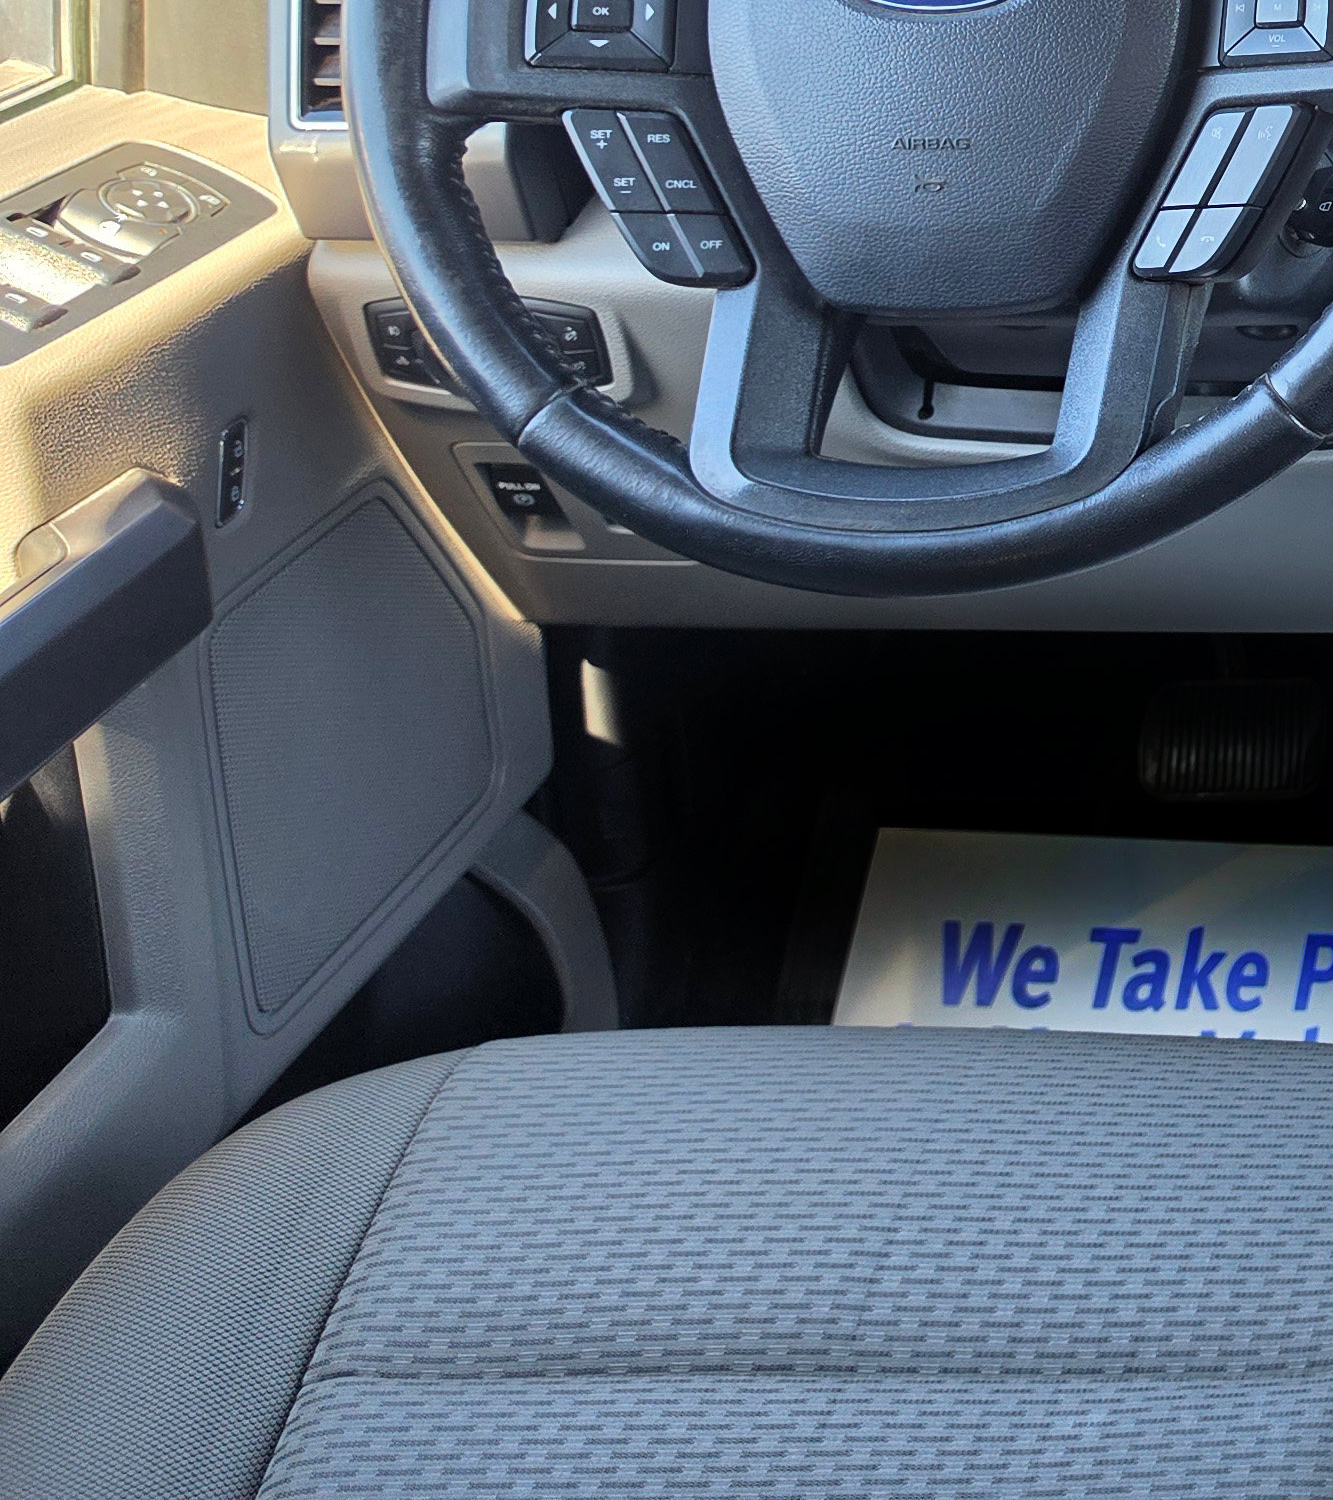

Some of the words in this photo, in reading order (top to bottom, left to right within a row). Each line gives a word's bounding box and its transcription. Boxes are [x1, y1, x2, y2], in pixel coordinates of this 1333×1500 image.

[593, 6, 610, 16] OK
[1273, 3, 1282, 12] M
[1268, 34, 1286, 43] VOL
[590, 129, 613, 139] SET
[647, 133, 671, 144] RES
[891, 137, 971, 151] AIRBAG
[613, 177, 636, 188] SET
[665, 179, 696, 189] CNCL
[652, 241, 670, 251] ON
[700, 240, 723, 250] OFF
[940, 918, 1060, 1010] We
[1088, 926, 1270, 1013] Take
